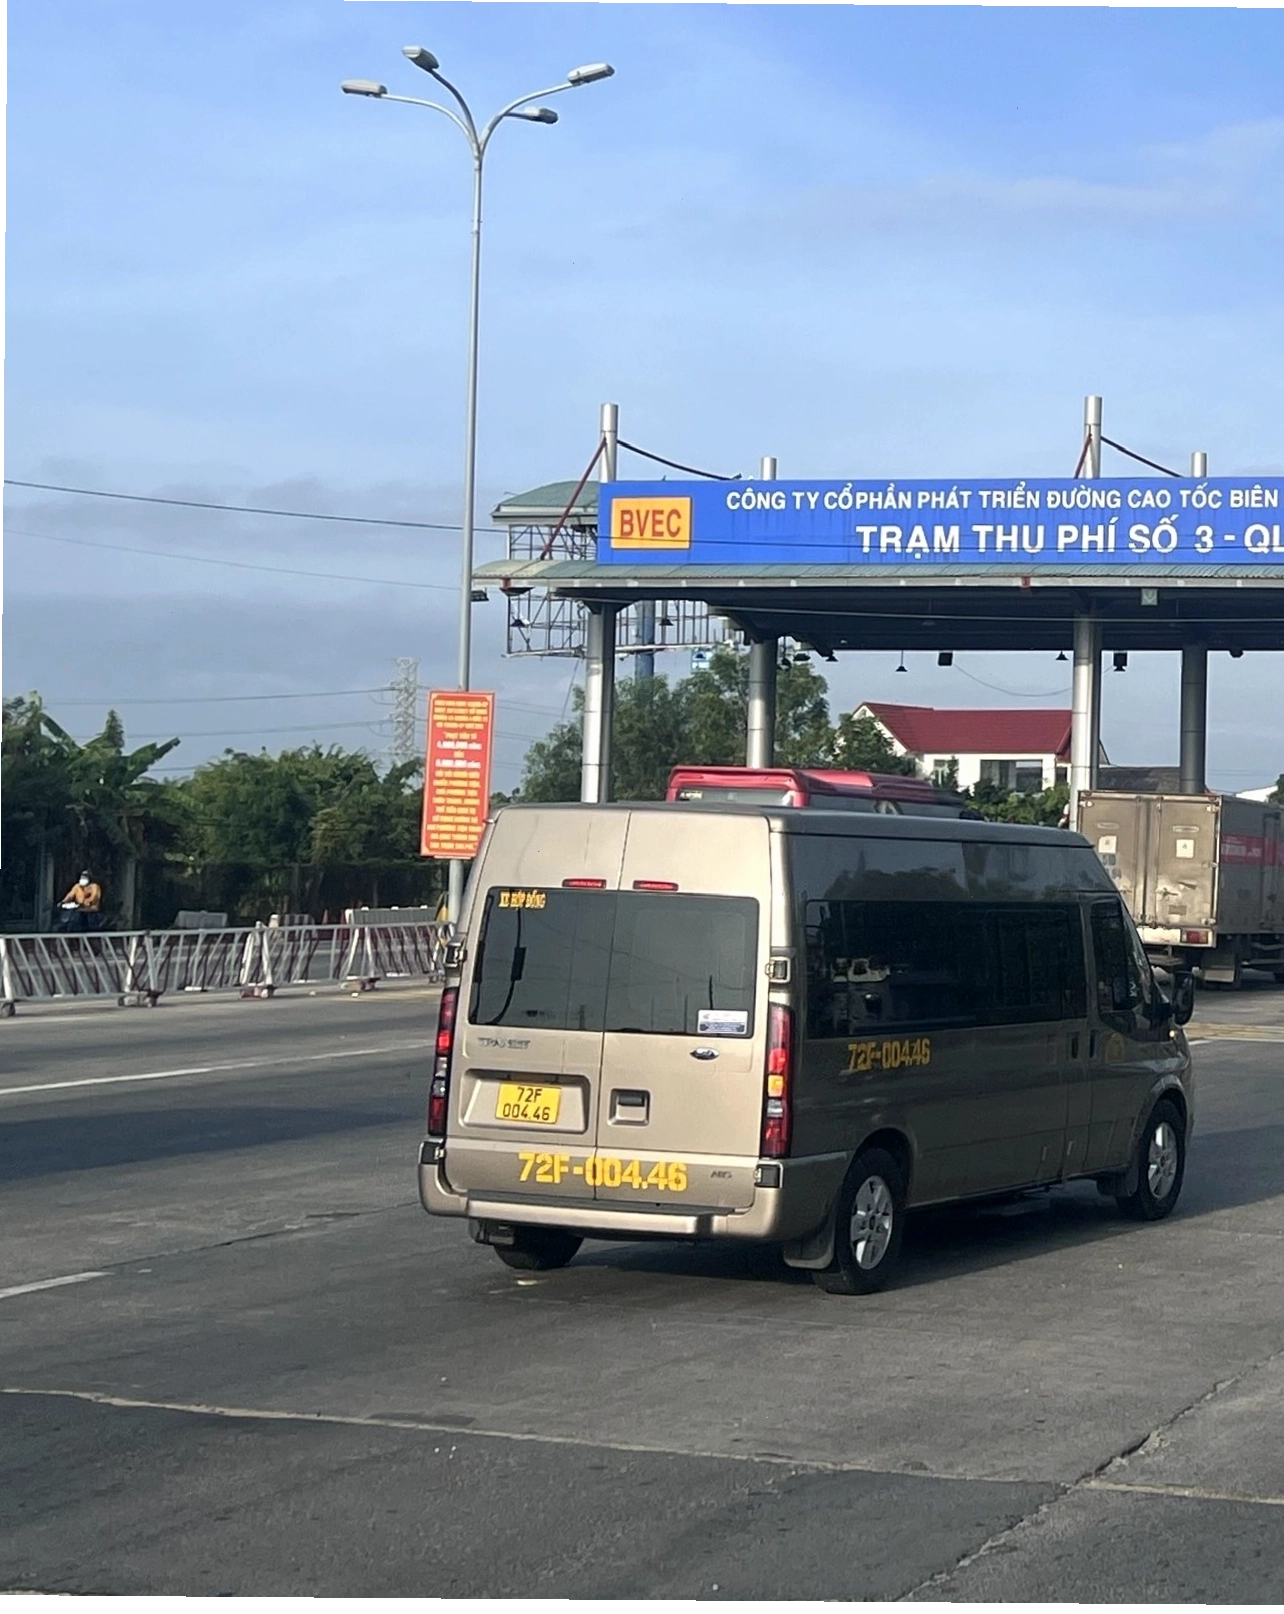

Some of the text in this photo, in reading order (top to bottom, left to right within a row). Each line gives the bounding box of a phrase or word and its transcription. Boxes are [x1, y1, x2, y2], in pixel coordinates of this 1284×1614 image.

[726, 487, 786, 510] CÔNG
[792, 491, 820, 510] TY
[823, 482, 853, 510] CỔ
[855, 482, 912, 509] PHẦN
[917, 485, 972, 509] PHÁT
[978, 480, 1040, 509] TRIỂN
[1046, 484, 1121, 509] ĐƯỜNG
[1127, 489, 1172, 509] CAO
[1179, 482, 1223, 509] TỐC
[1230, 484, 1278, 508] BIÊN
[620, 508, 682, 538] BVEC
[855, 524, 960, 559] TRẠM
[971, 524, 1045, 553] THU
[1057, 516, 1119, 553] PHÍ
[1128, 513, 1179, 553] SỐ
[1194, 524, 1214, 553] 3
[517, 1086, 543, 1104] 72F
[502, 1102, 551, 1121] 004.46
[518, 1151, 688, 1192] 72F-004.46
